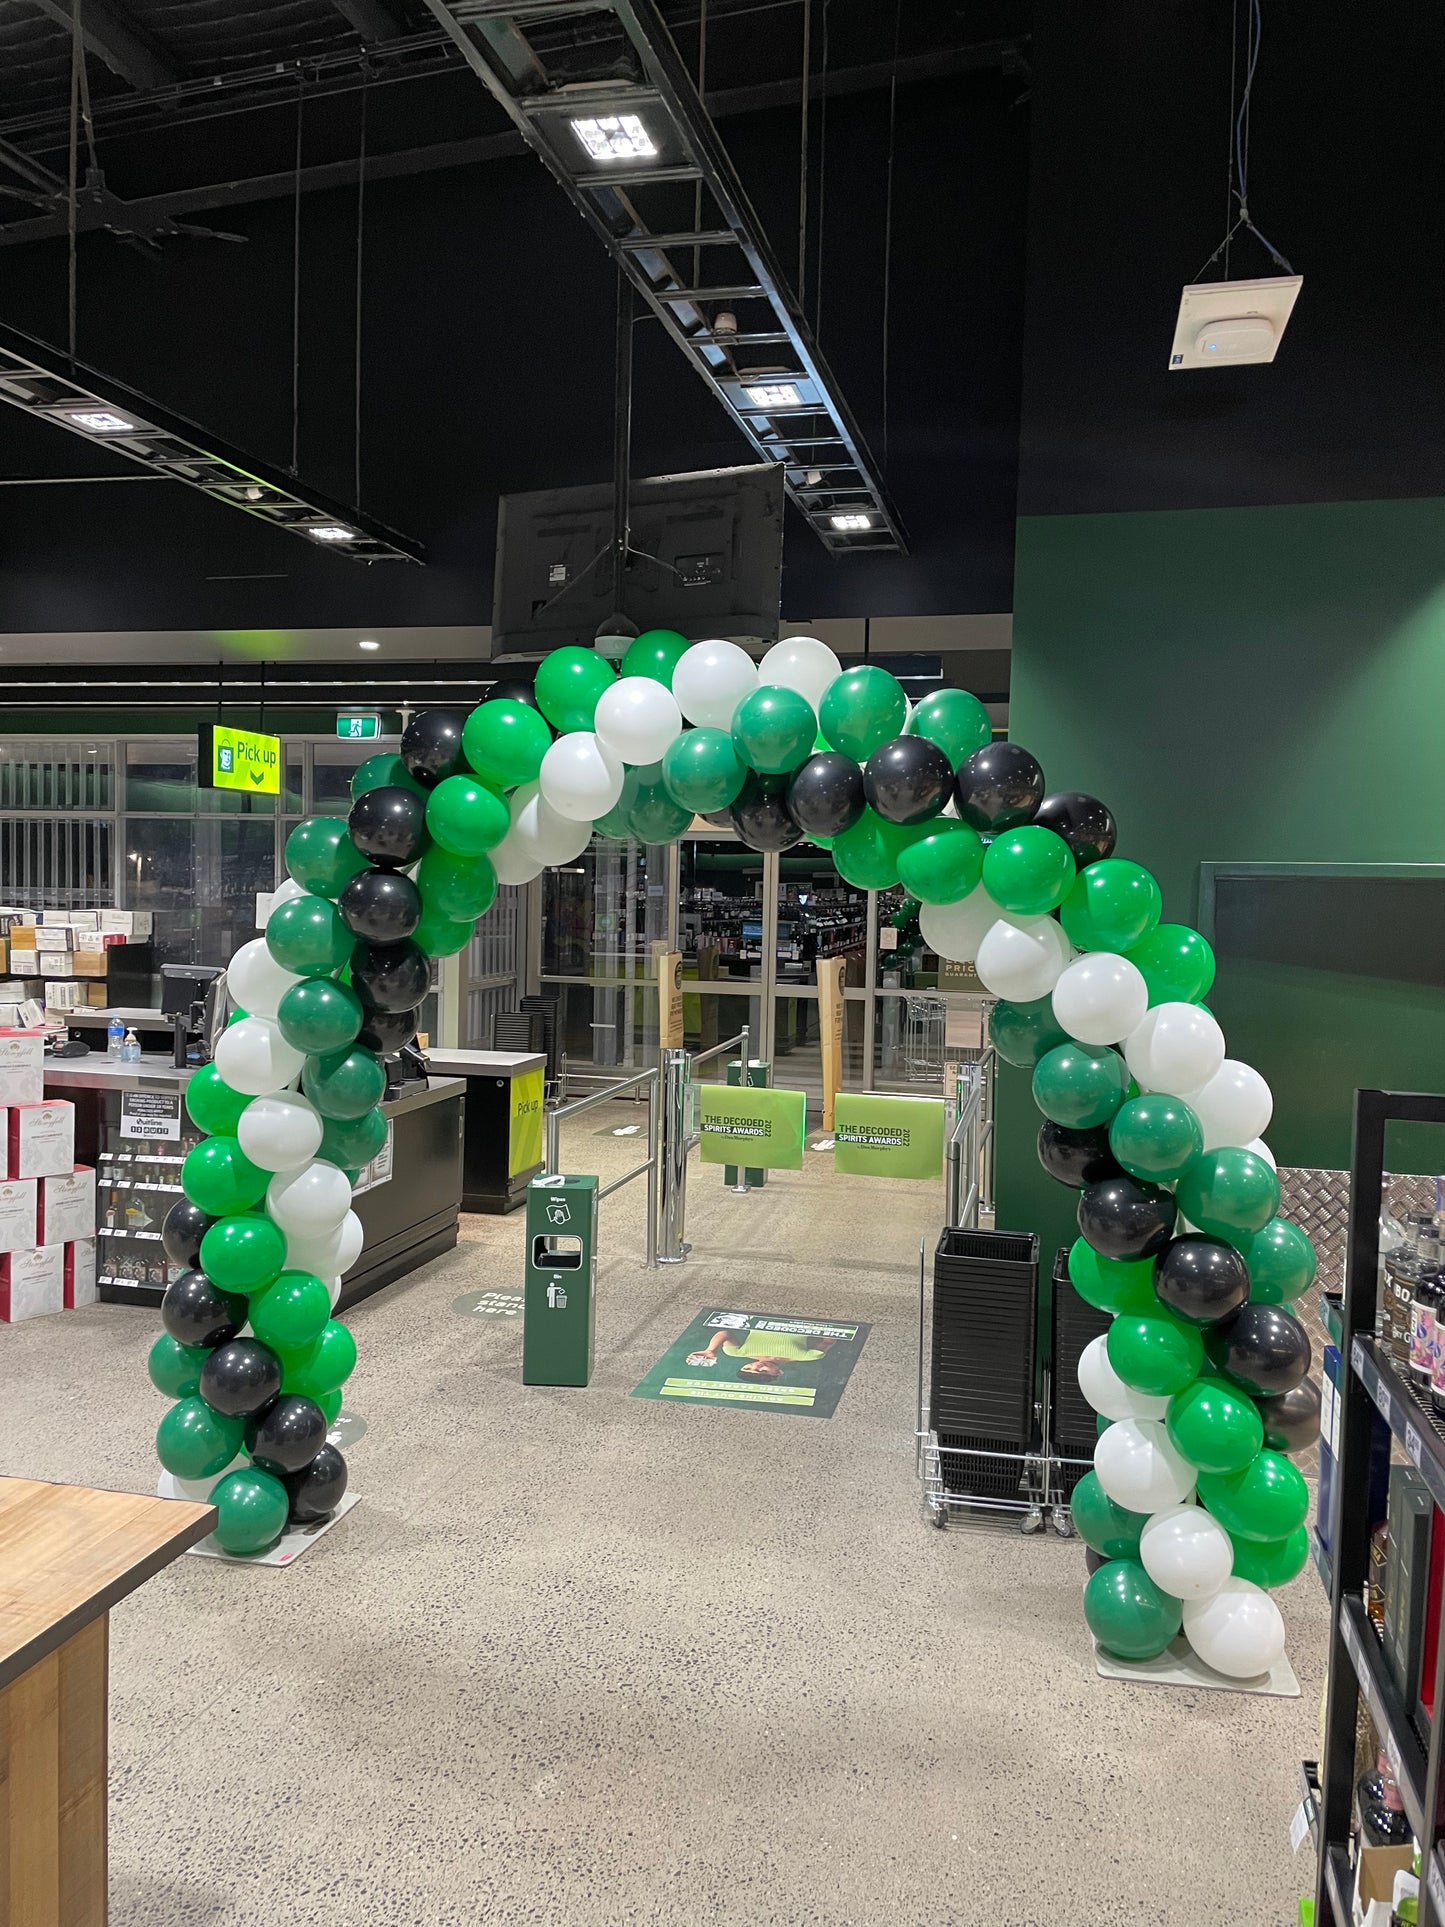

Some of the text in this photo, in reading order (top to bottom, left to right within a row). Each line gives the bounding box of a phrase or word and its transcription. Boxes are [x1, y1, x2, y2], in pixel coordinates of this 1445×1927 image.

[237, 741, 277, 768] Pick up
[945, 964, 974, 972] PRIC
[517, 1100, 538, 1117] Pick up
[705, 1115, 764, 1127] THE DECODED
[704, 1124, 764, 1136] SPIRITS AWARDS
[840, 1125, 902, 1137] THE DECODED
[839, 1134, 902, 1146] SPIRITS AWARDS
[903, 1128, 911, 1147] 2022
[472, 1306, 518, 1316] here
[765, 1325, 848, 1338] THE DECODED
